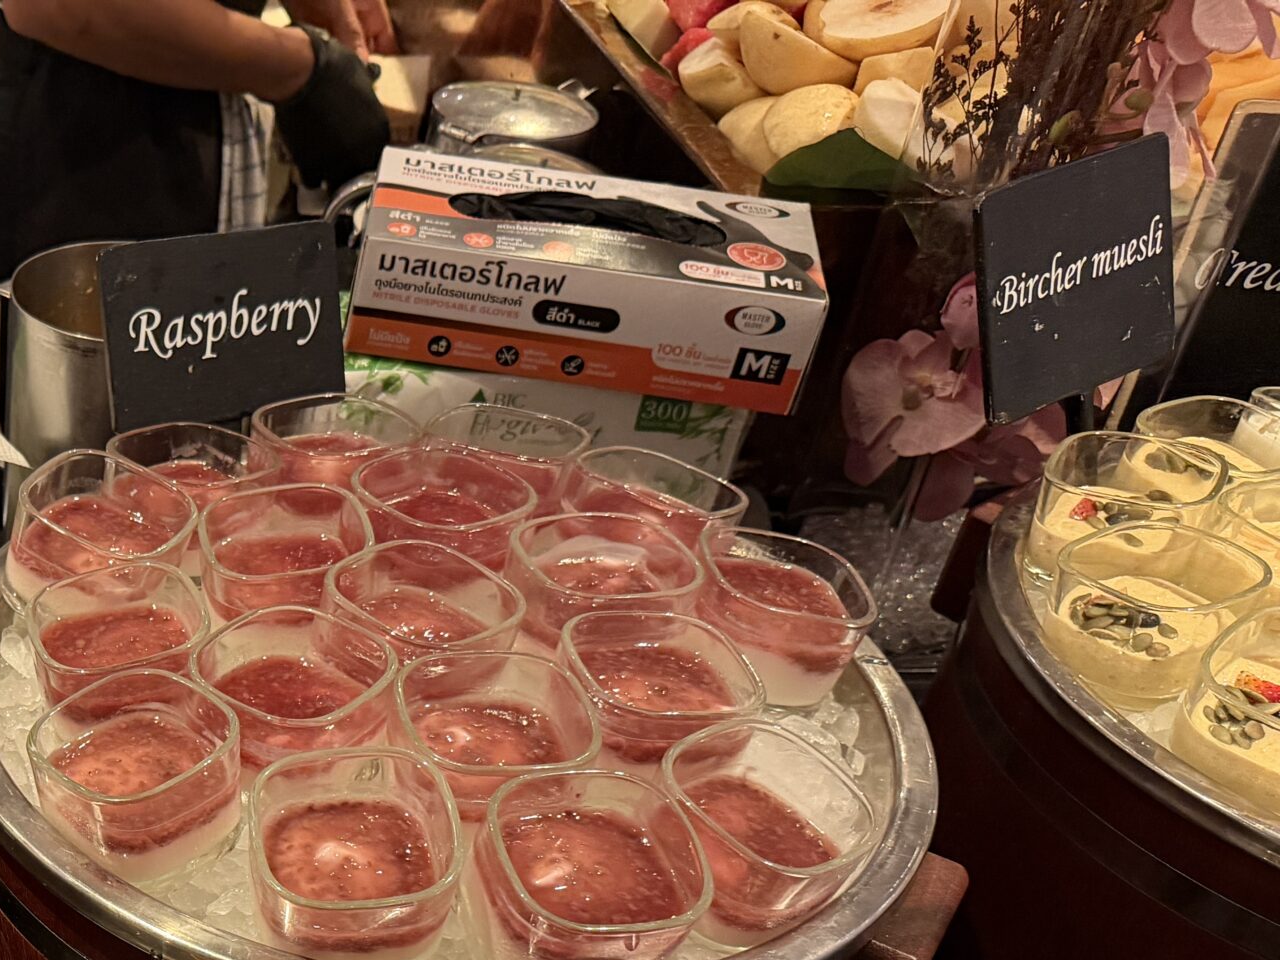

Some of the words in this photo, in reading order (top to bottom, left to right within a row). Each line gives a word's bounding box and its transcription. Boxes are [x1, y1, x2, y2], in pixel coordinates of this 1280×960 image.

[404, 156, 598, 191] มาสเตอร์โกลฟ
[378, 253, 567, 297] มาสเตอร์โกลฟ
[995, 251, 1088, 315] Bircher
[1091, 214, 1164, 279] muesli
[770, 275, 795, 290] M
[128, 288, 321, 360] Raspberry
[545, 304, 577, 325] สีดำ
[741, 312, 771, 324] MASTER
[657, 343, 683, 356] 100
[739, 352, 772, 379] M
[640, 401, 687, 423] 300
